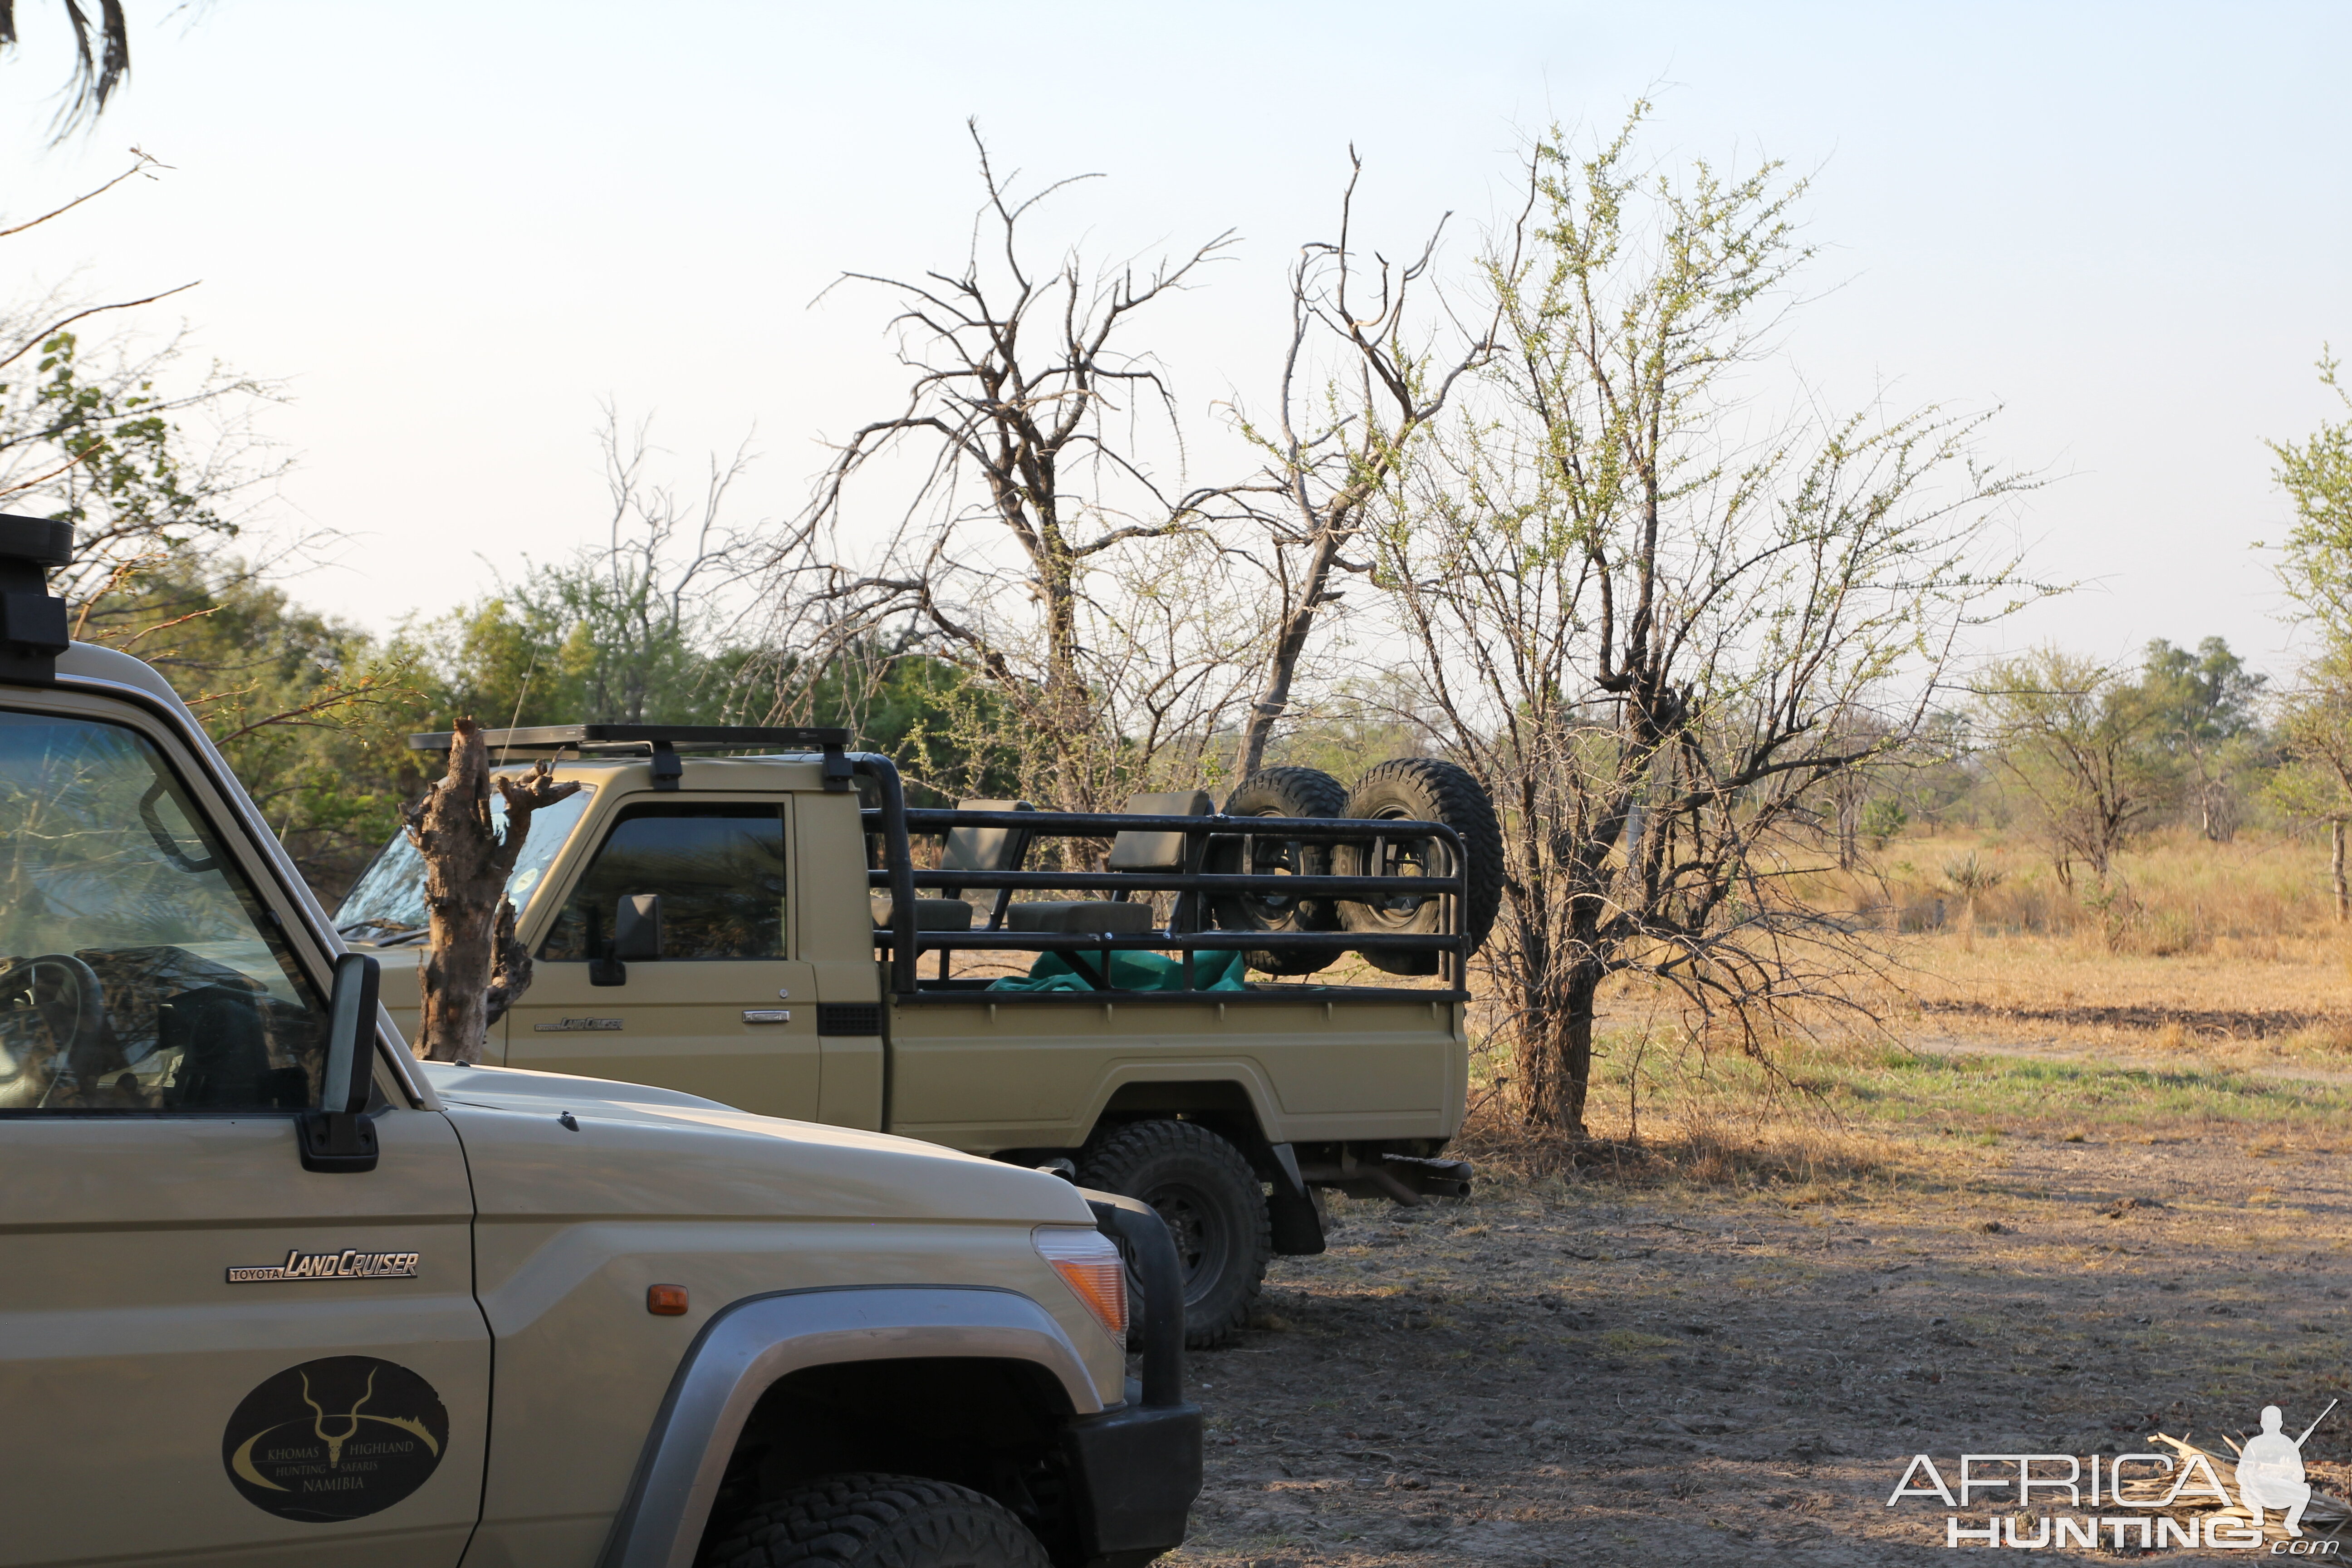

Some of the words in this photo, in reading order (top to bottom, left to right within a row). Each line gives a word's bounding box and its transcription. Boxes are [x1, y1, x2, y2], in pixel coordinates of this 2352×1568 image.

[232, 1269, 279, 1280] TOYOTA
[268, 1446, 319, 1460] KHOMAS
[350, 1441, 414, 1455] HIGHLAND
[275, 1464, 326, 1476] HUNTING
[340, 1460, 378, 1472] SAFARIS
[303, 1476, 364, 1492] NAMIBIA
